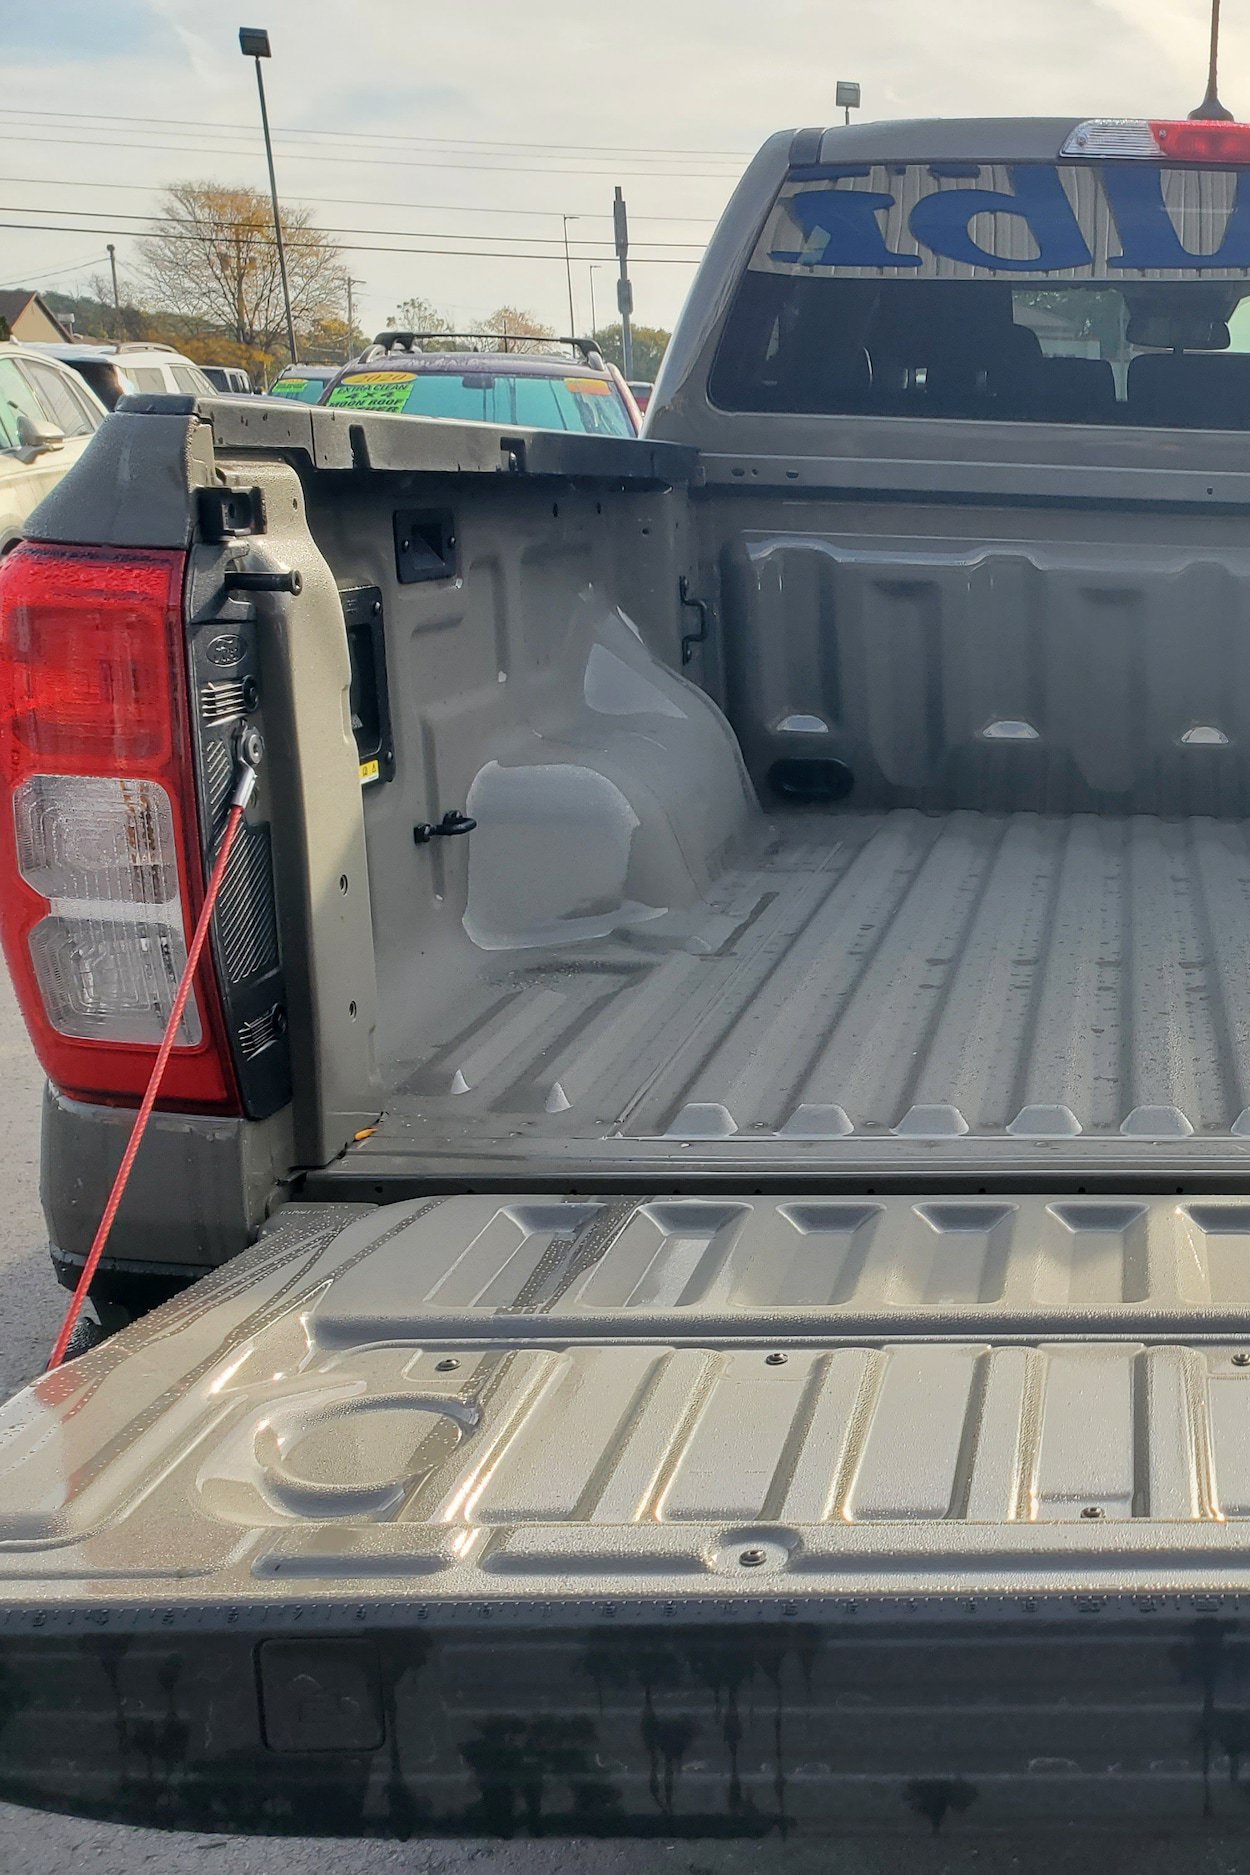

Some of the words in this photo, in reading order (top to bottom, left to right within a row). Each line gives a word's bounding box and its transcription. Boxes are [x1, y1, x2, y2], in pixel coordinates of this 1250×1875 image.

[336, 385, 371, 394] EXTRA
[373, 384, 408, 392] CLEAN
[329, 400, 365, 408] MOON
